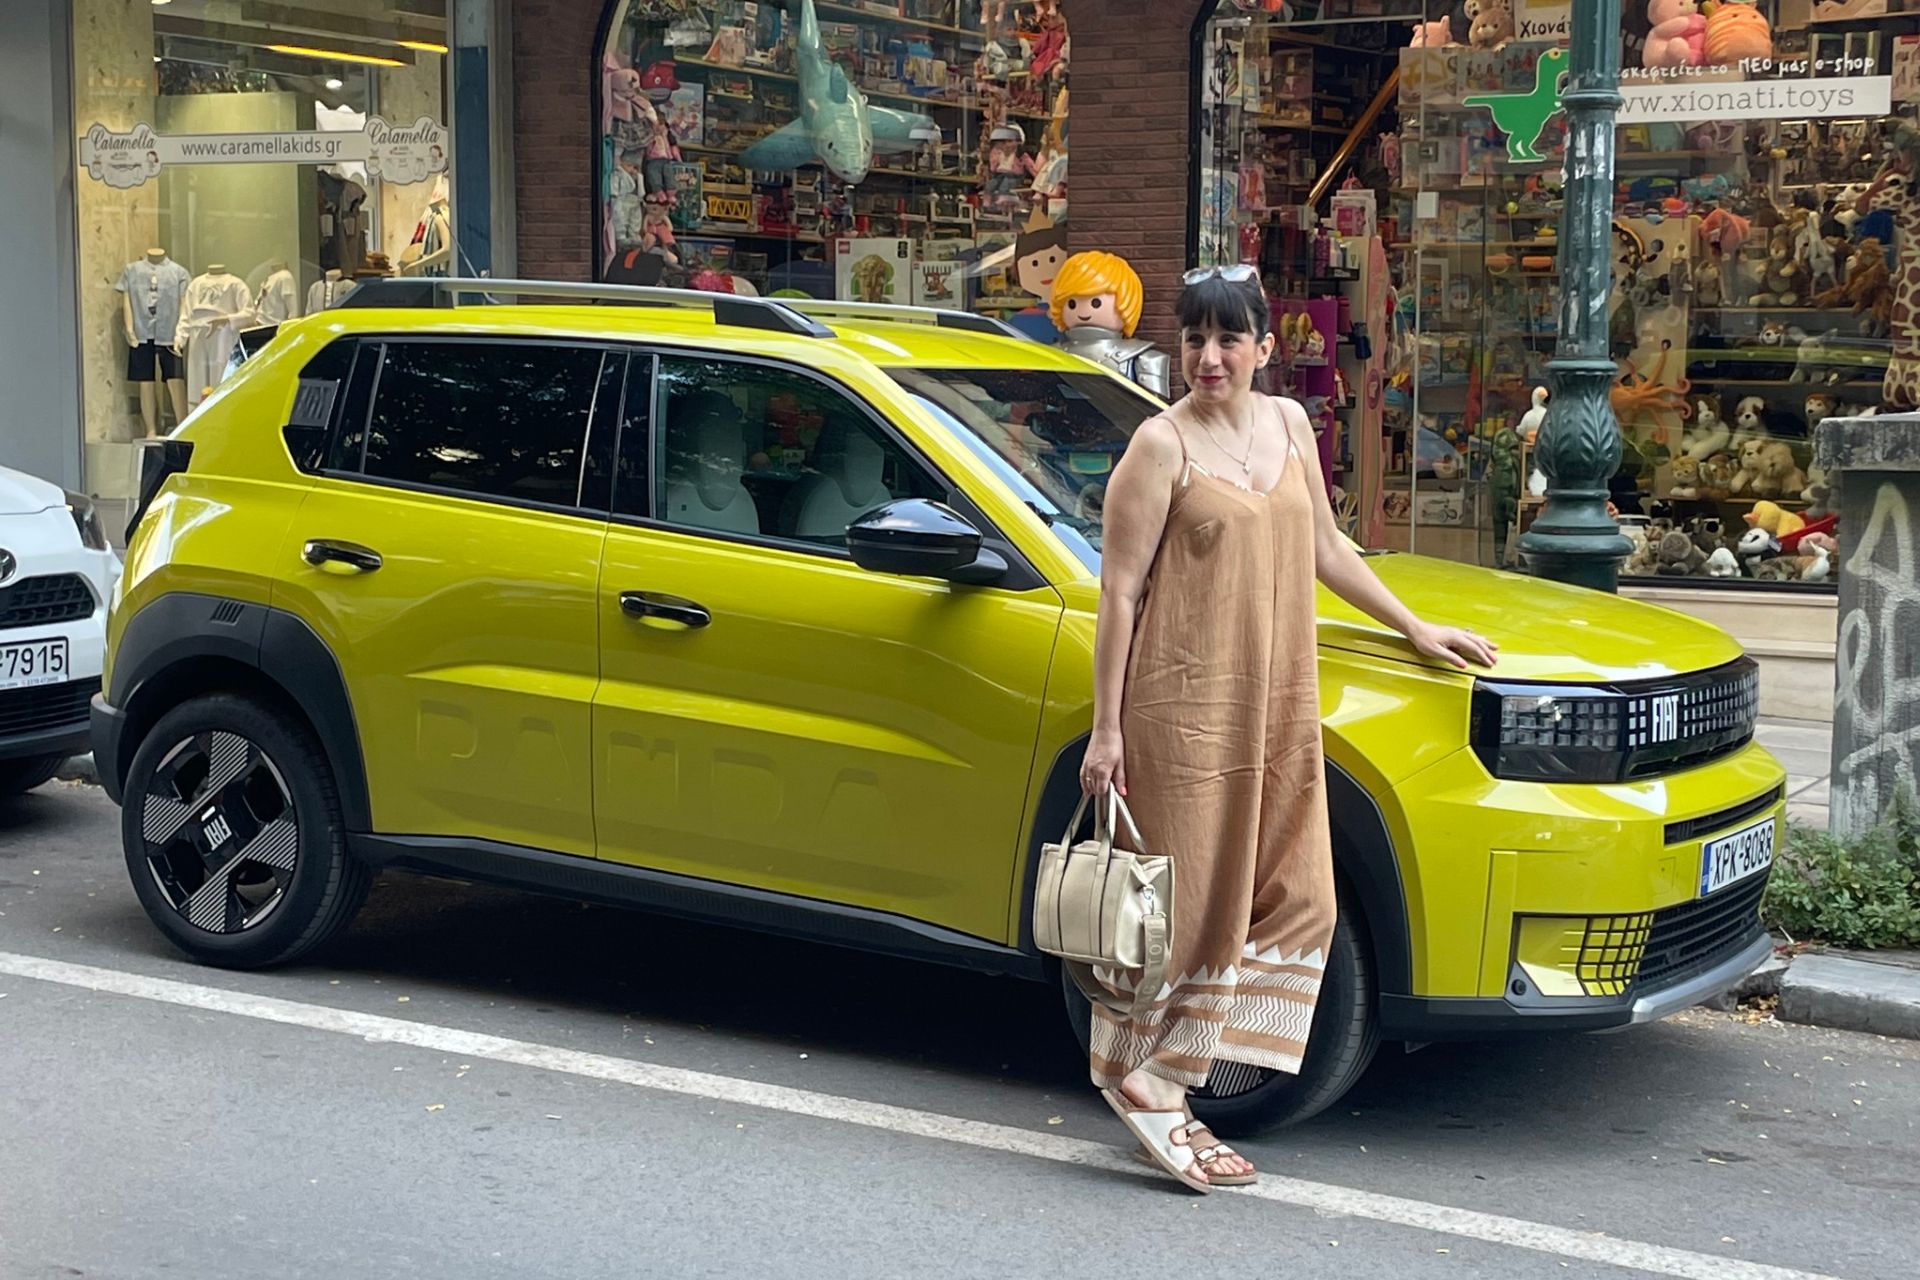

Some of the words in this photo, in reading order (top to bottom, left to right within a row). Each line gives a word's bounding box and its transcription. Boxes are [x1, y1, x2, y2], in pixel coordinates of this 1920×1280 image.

[1815, 52, 1875, 76] e-shop
[1617, 86, 1855, 113] ww.xionati.toys
[90, 128, 157, 151] Caramella
[367, 121, 441, 146] Caramella
[181, 136, 342, 157] www.caramellakids.gr
[1651, 695, 1680, 743] FIAT
[203, 814, 233, 851] FIAT
